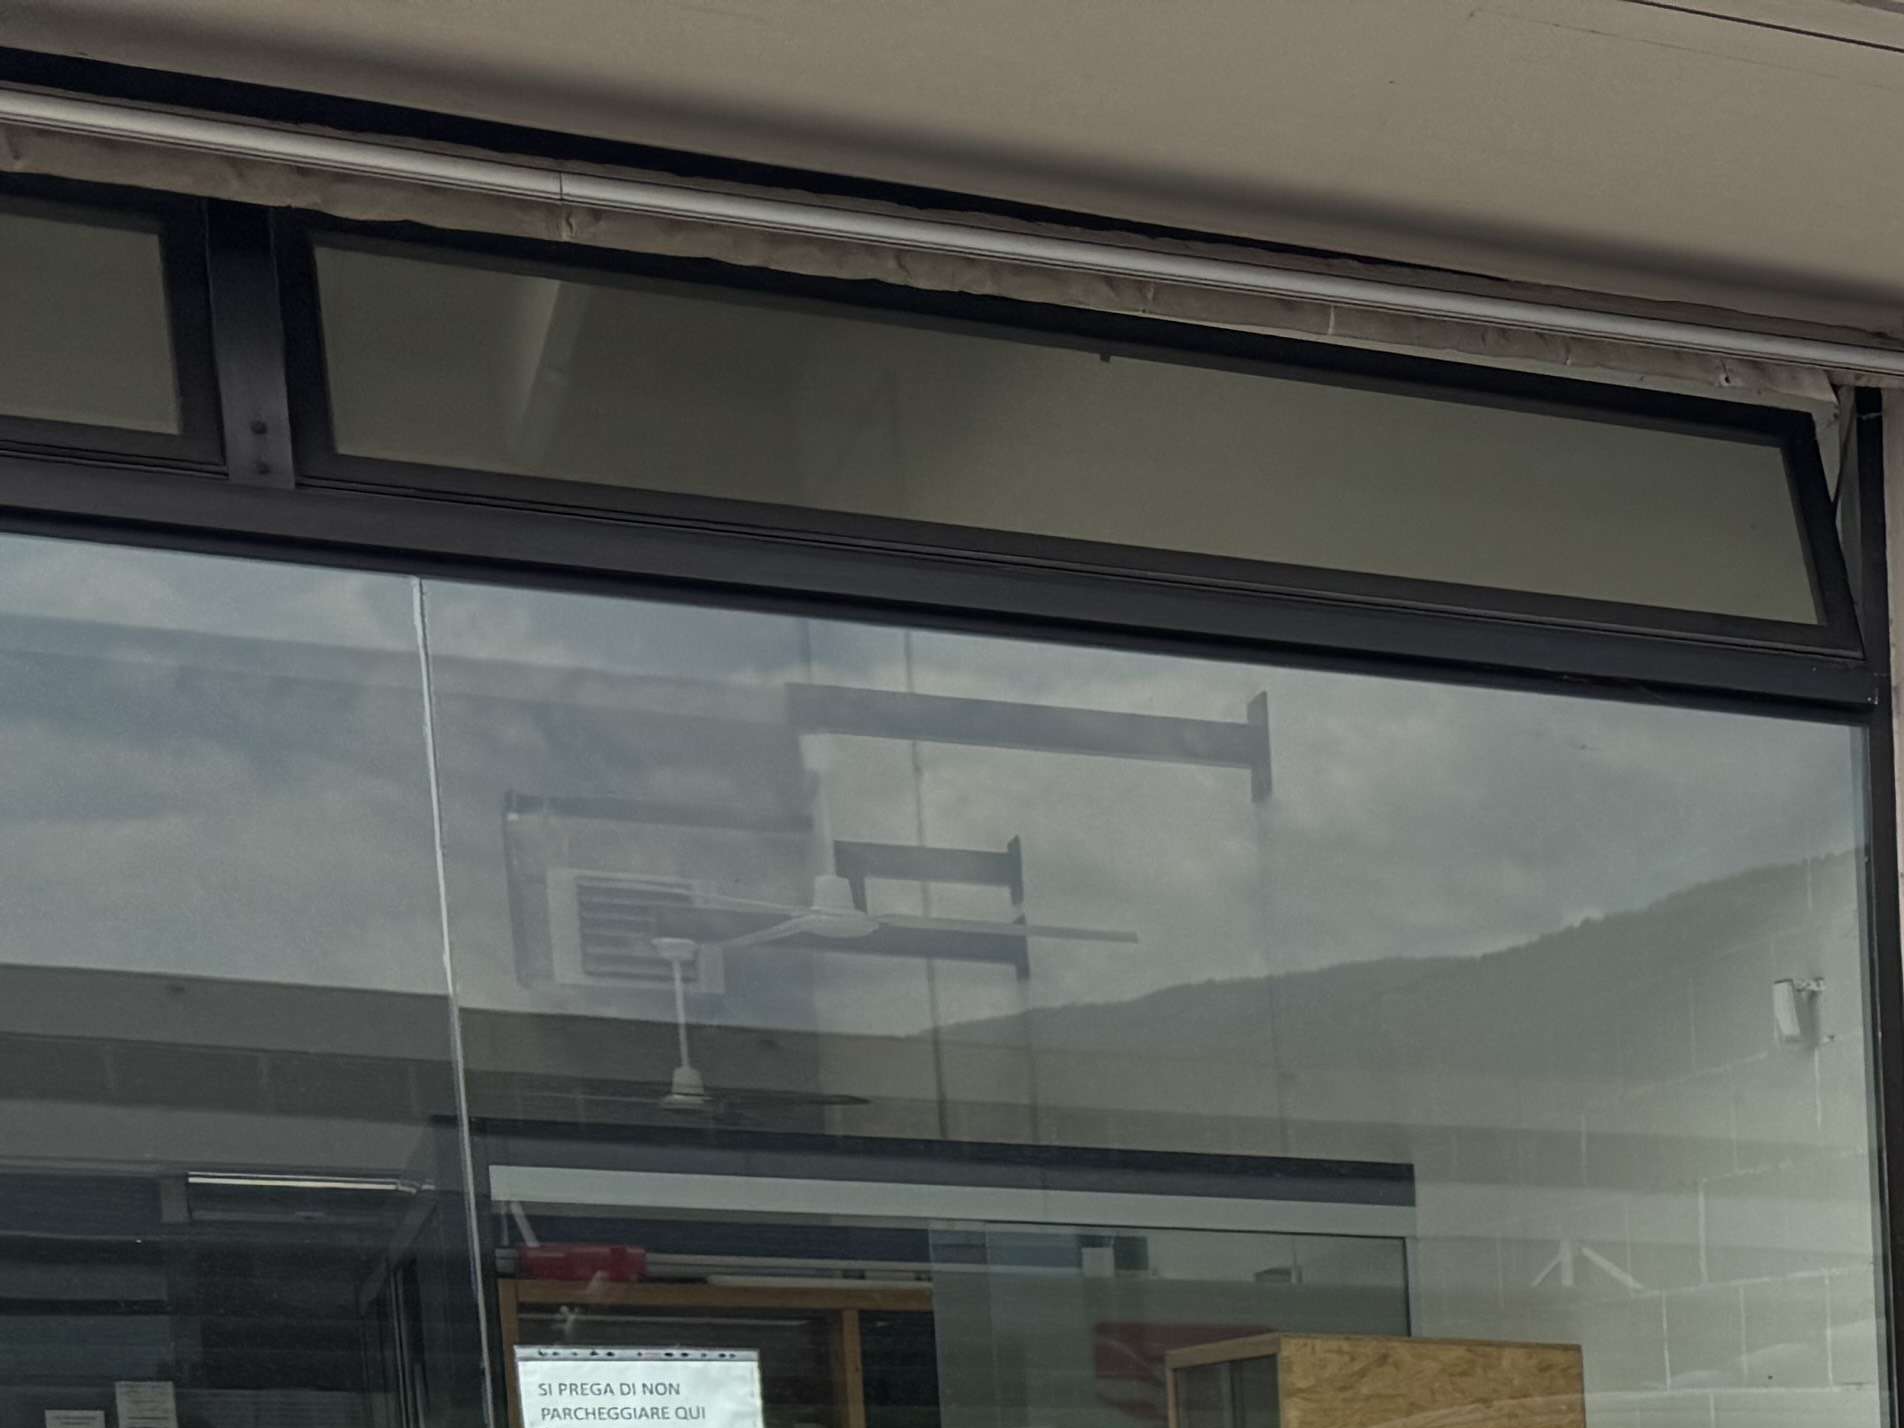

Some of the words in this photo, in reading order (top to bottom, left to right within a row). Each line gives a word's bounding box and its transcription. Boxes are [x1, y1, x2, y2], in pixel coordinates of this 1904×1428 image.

[538, 1383, 553, 1396] SI
[558, 1383, 614, 1396] PREGA
[620, 1383, 636, 1396] DI
[642, 1383, 681, 1396] NON
[541, 1406, 670, 1421] PARCHEGGIARE
[675, 1406, 706, 1420] QUI
